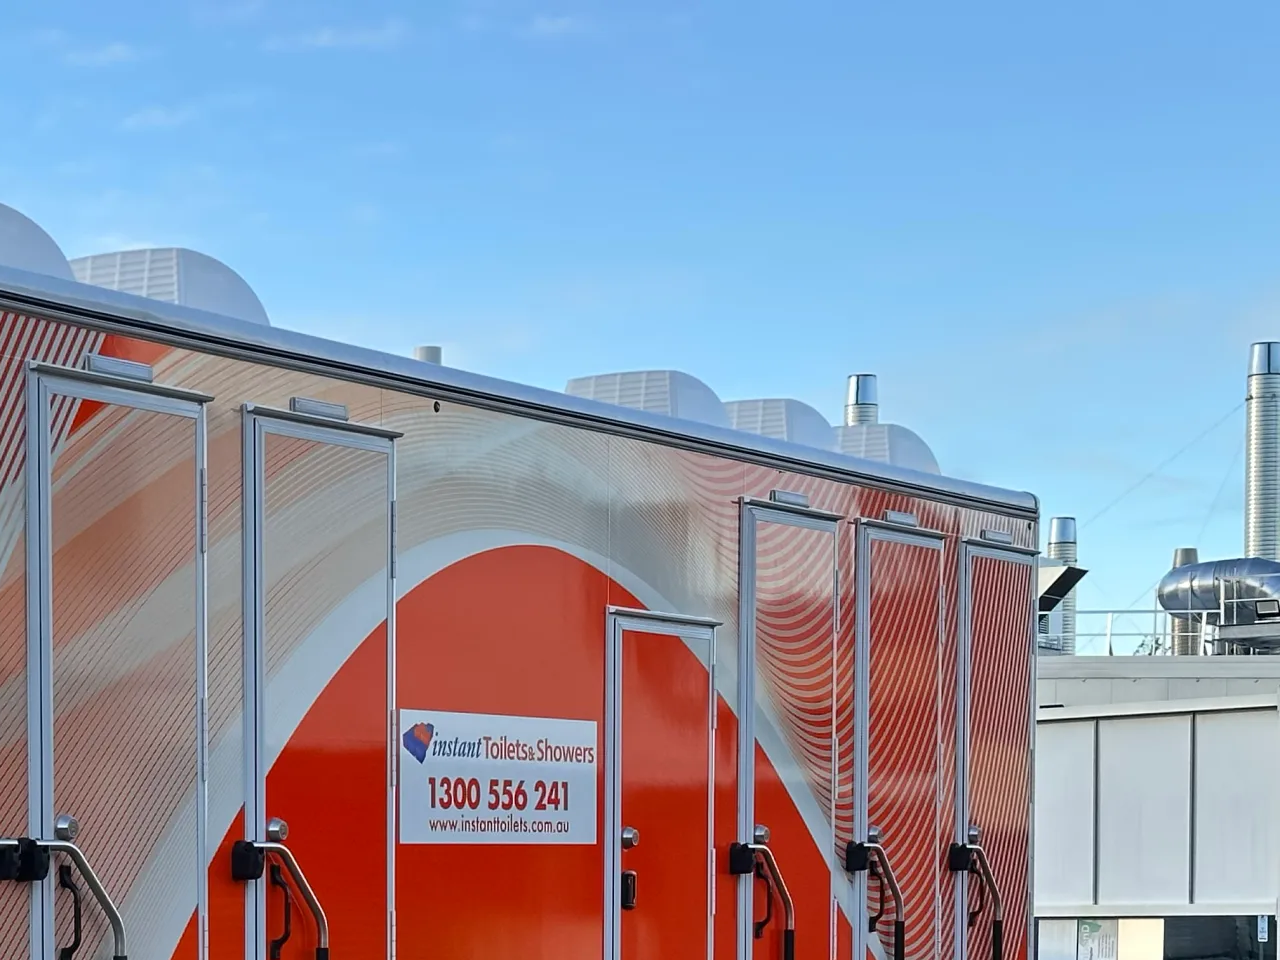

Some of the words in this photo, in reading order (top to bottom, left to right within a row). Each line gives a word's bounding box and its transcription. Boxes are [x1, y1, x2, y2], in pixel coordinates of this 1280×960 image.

[432, 731, 482, 759] instant
[483, 736, 528, 761] Toilets
[536, 738, 595, 764] Showers
[428, 776, 481, 810] 1300
[488, 779, 528, 811] 556
[534, 780, 569, 812] 241
[429, 814, 570, 834] www.instanttoilets.com.au
